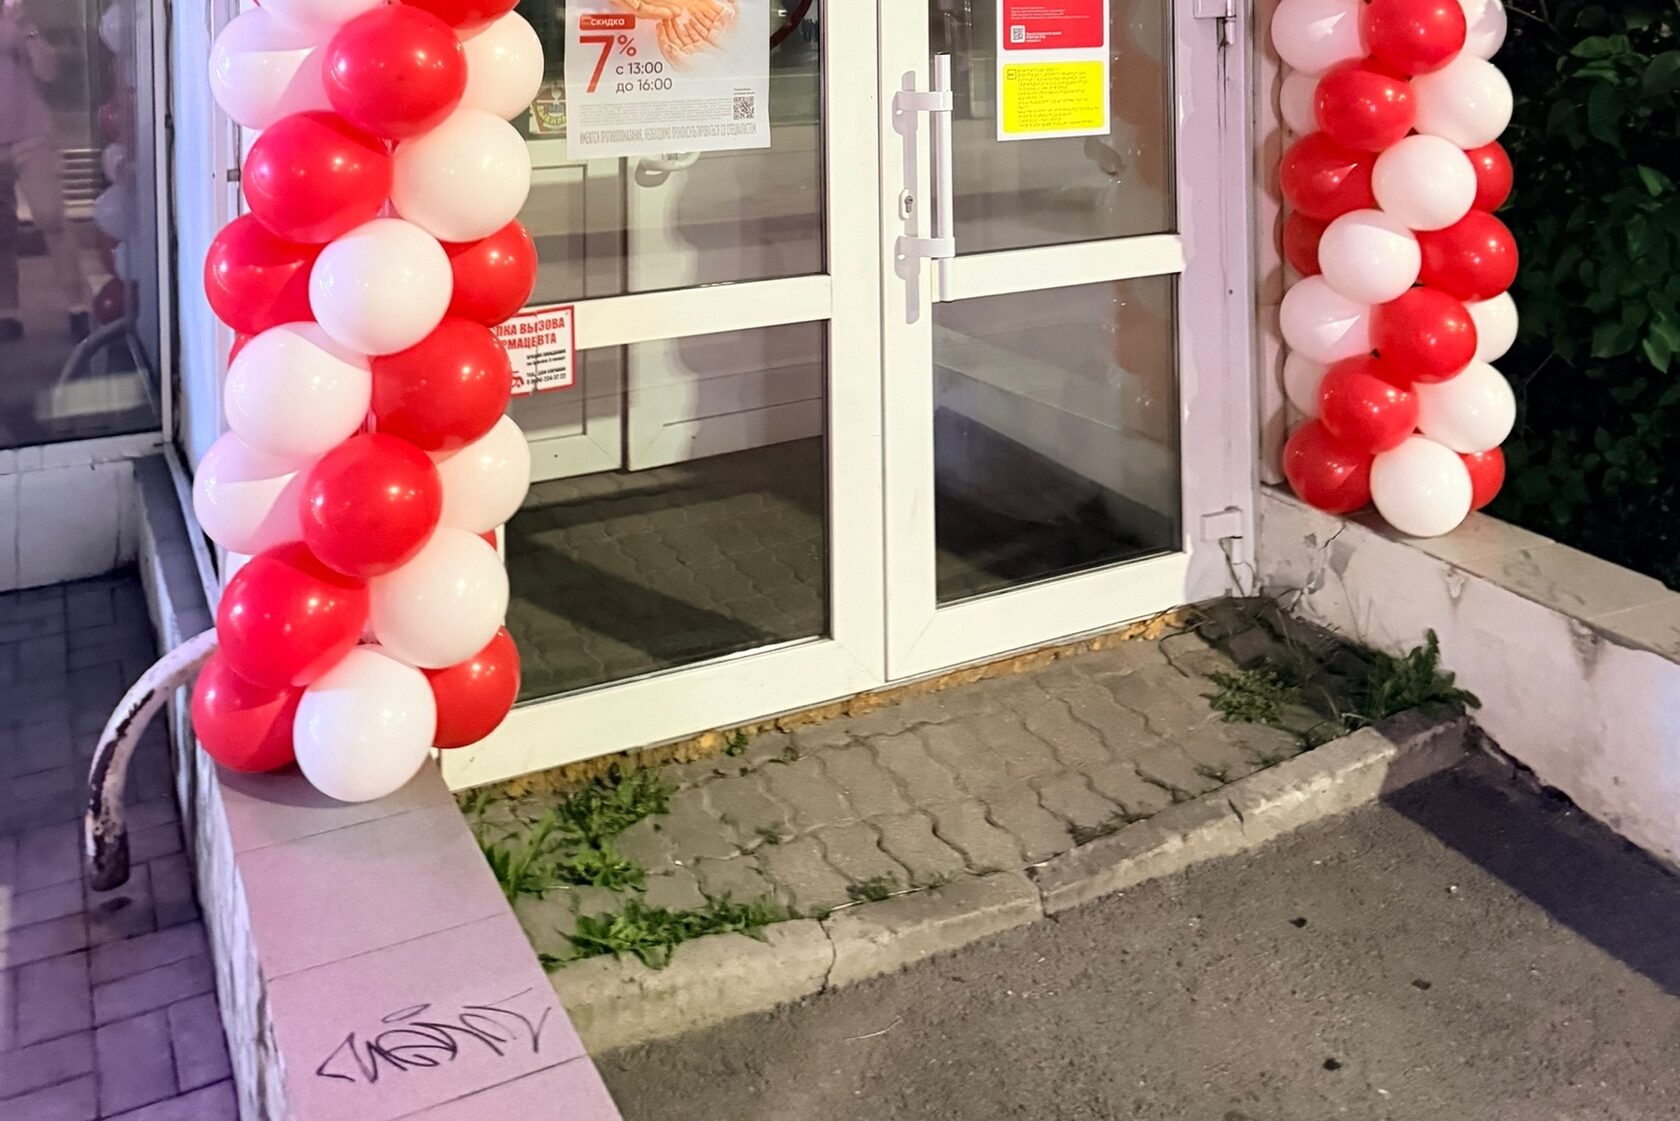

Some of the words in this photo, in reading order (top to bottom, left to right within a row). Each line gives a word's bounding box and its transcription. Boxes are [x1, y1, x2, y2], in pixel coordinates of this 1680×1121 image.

[627, 60, 664, 76] 13:00
[615, 81, 635, 94] до
[637, 76, 673, 92] 16:00
[494, 324, 517, 337] ПКА
[519, 317, 565, 335] ВЫЗОВА
